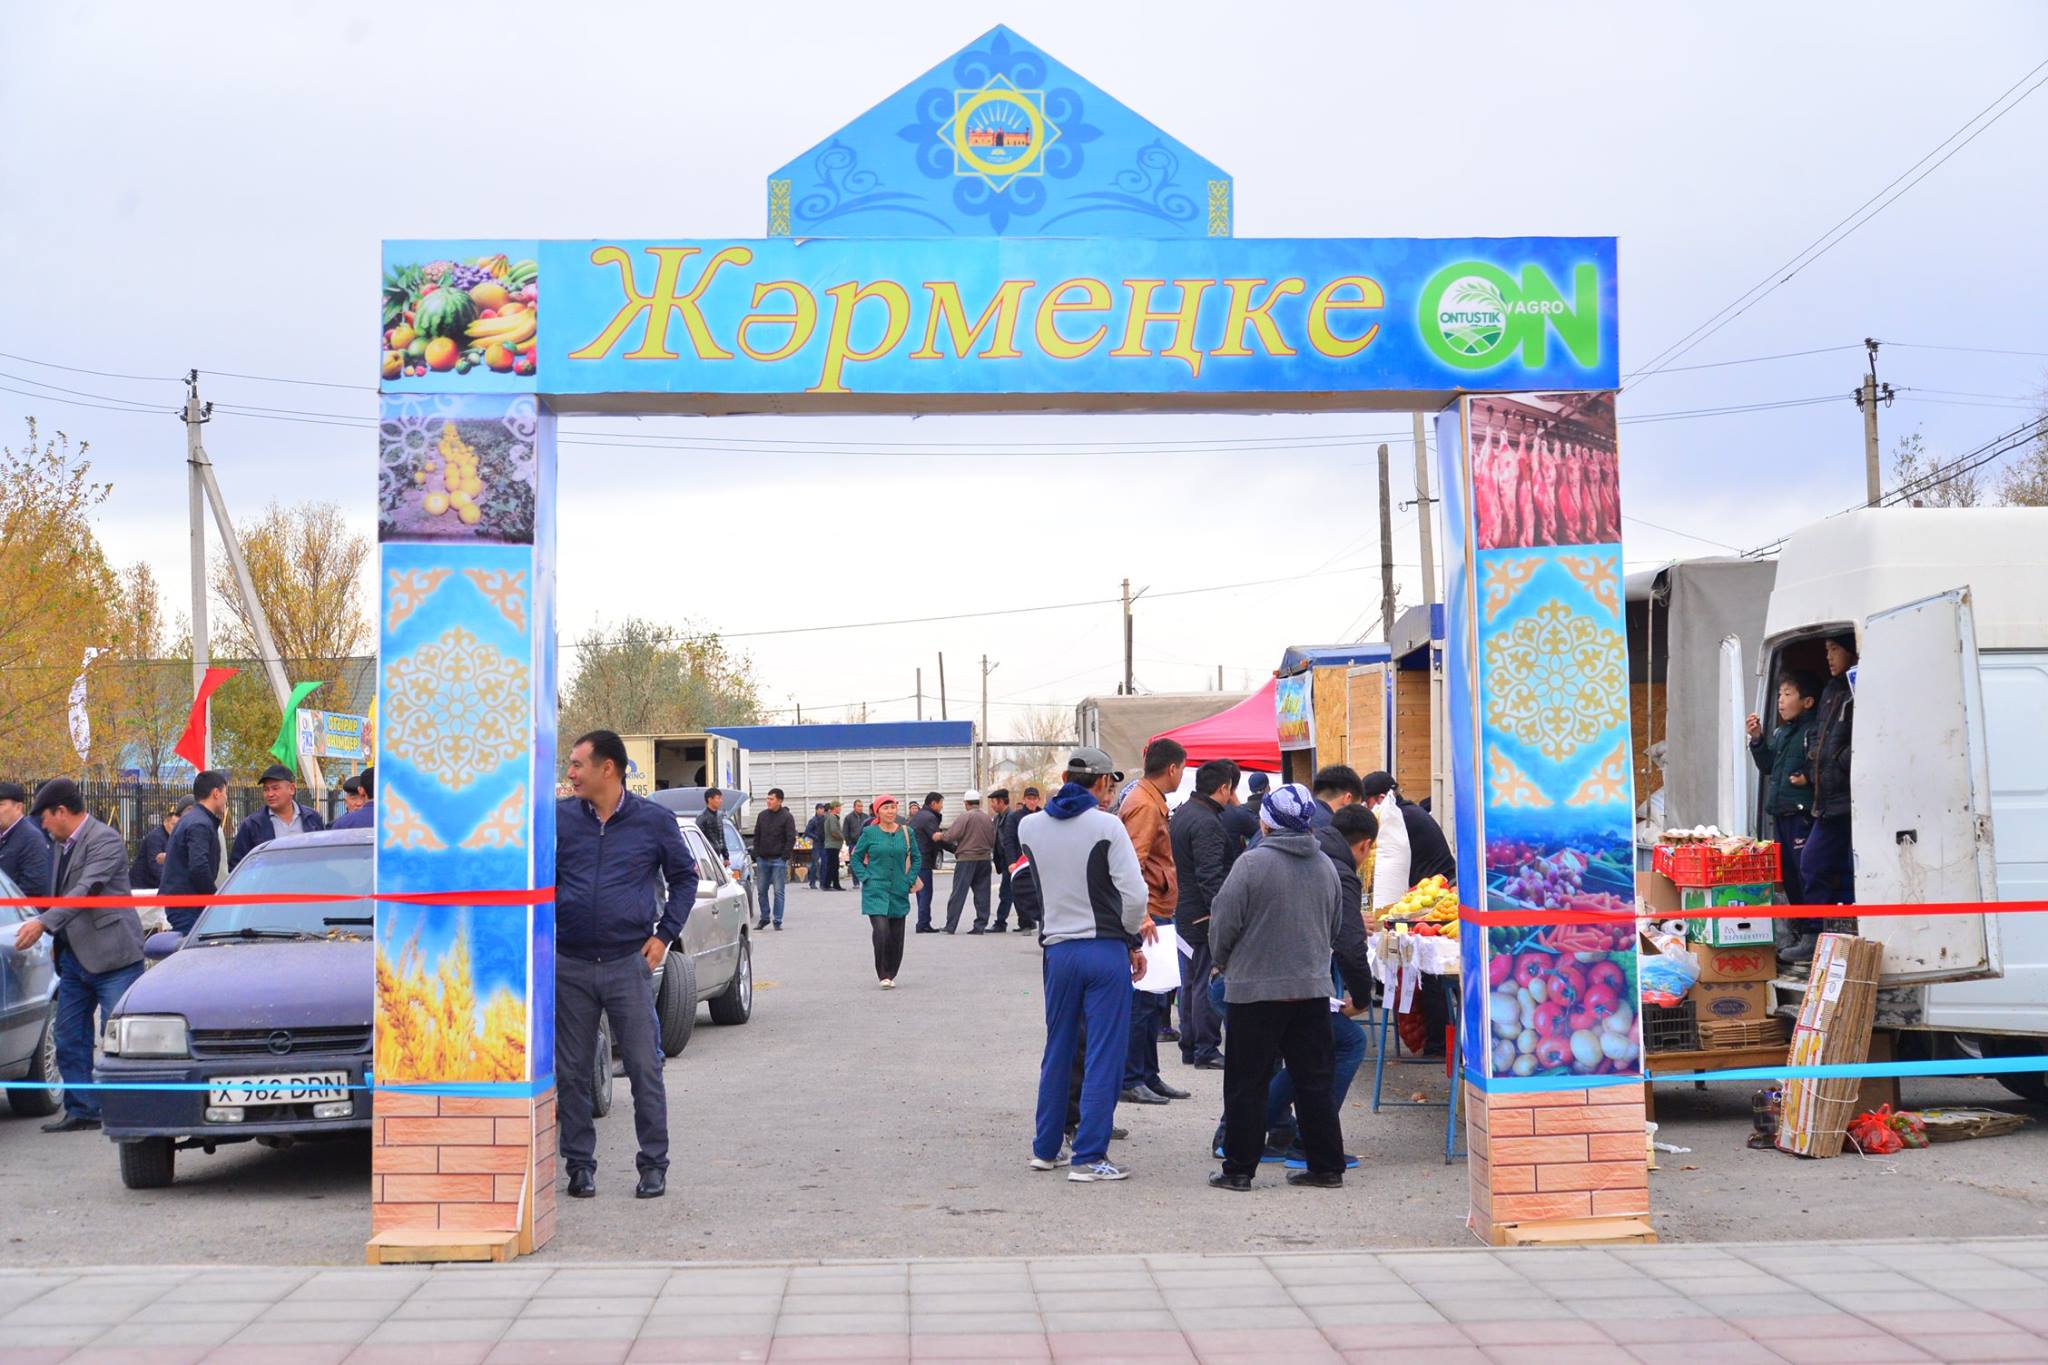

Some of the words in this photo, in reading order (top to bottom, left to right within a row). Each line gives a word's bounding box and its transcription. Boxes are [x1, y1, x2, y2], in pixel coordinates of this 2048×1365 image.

[568, 246, 1385, 393] Жәрмеңке
[1440, 312, 1501, 324] ONTUSTIK
[242, 1079, 283, 1102] 962
[290, 1076, 342, 1099] DRN
